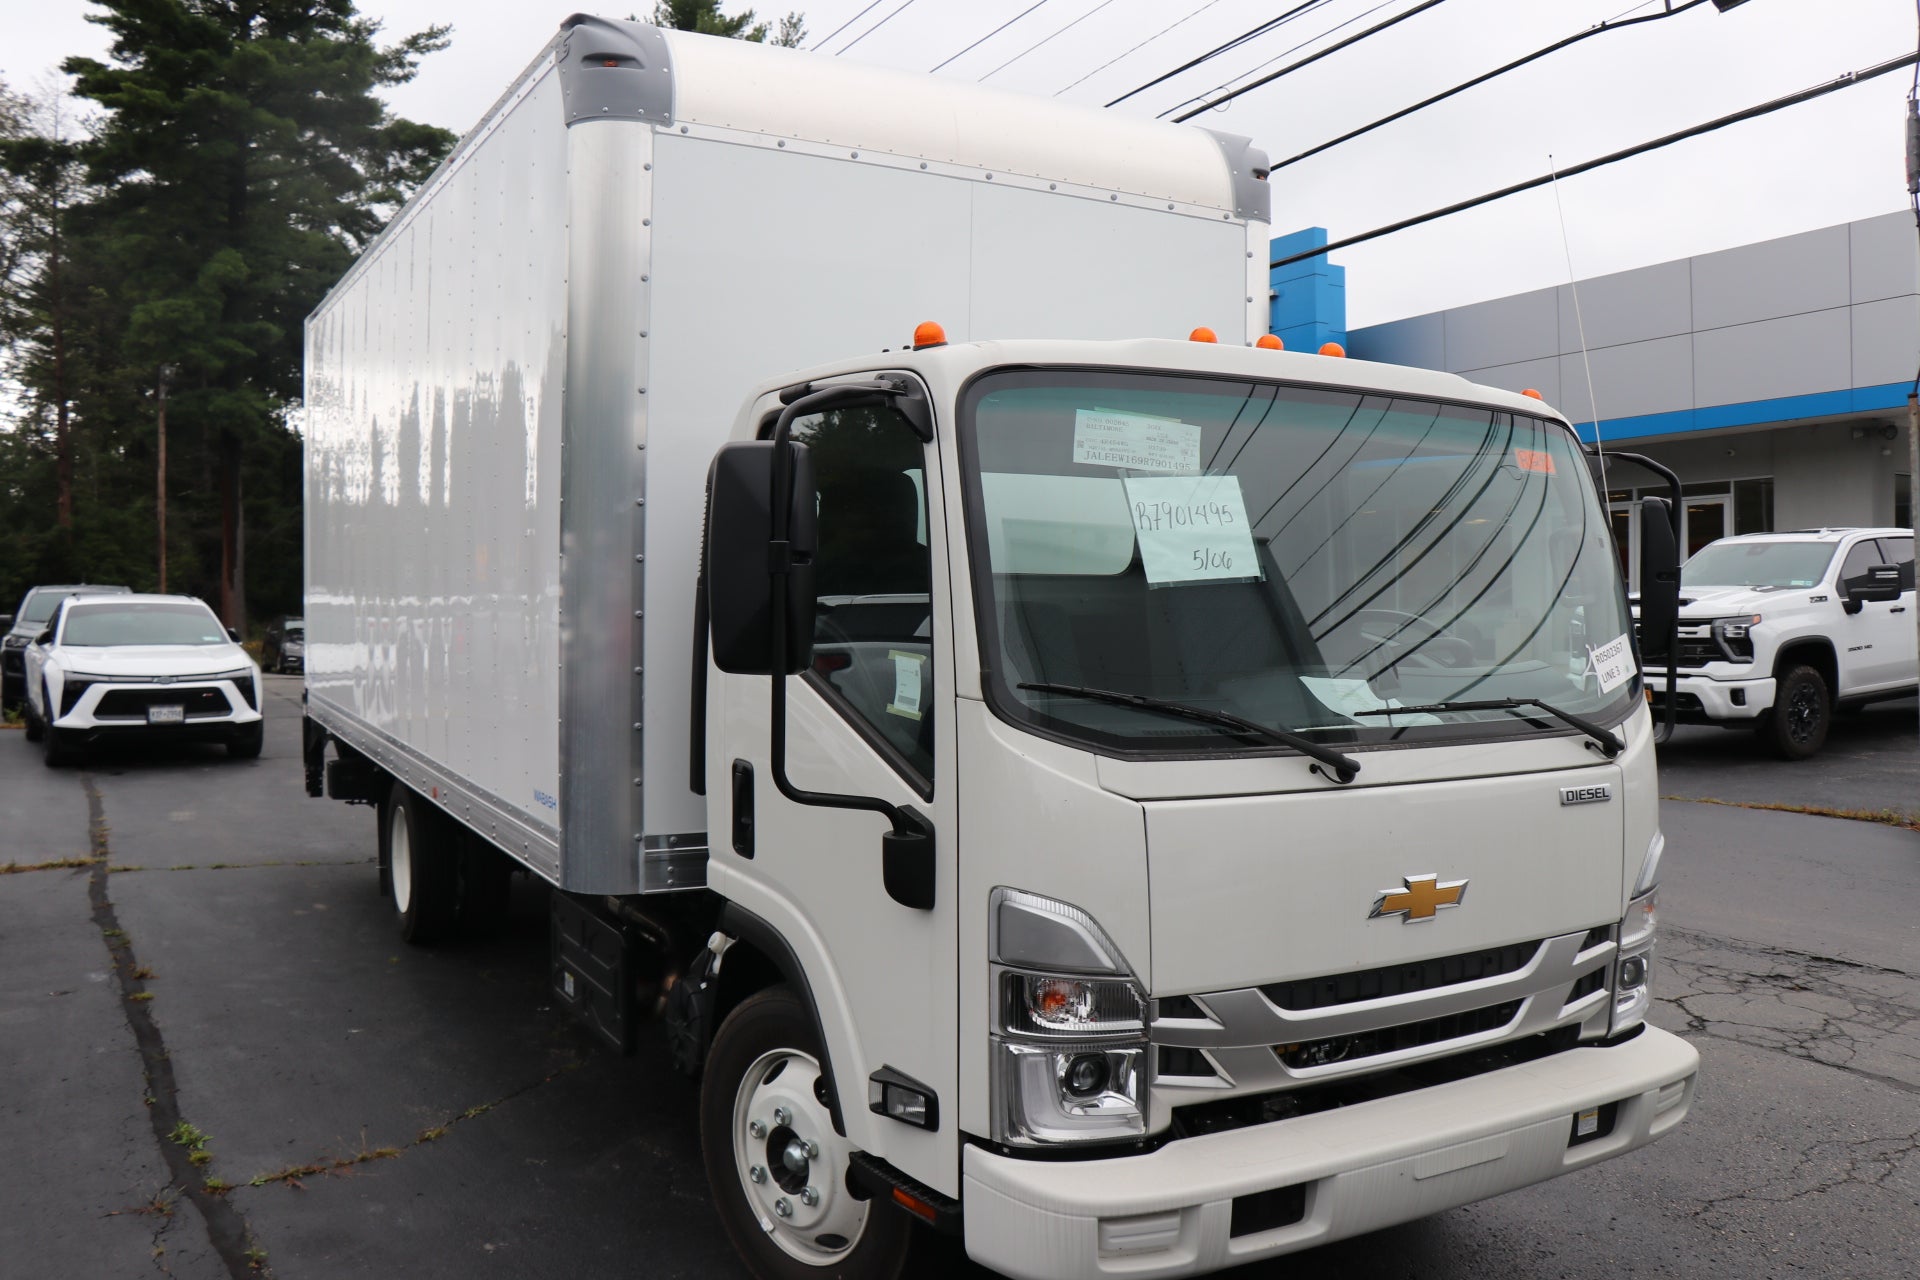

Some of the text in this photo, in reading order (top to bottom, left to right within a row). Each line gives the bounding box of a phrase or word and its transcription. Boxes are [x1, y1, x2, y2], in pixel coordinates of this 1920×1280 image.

[1136, 501, 1234, 531] R7901495
[1193, 548, 1233, 571] 5/06
[1601, 665, 1621, 684] LINE 3
[1566, 787, 1609, 802] DIESEL
